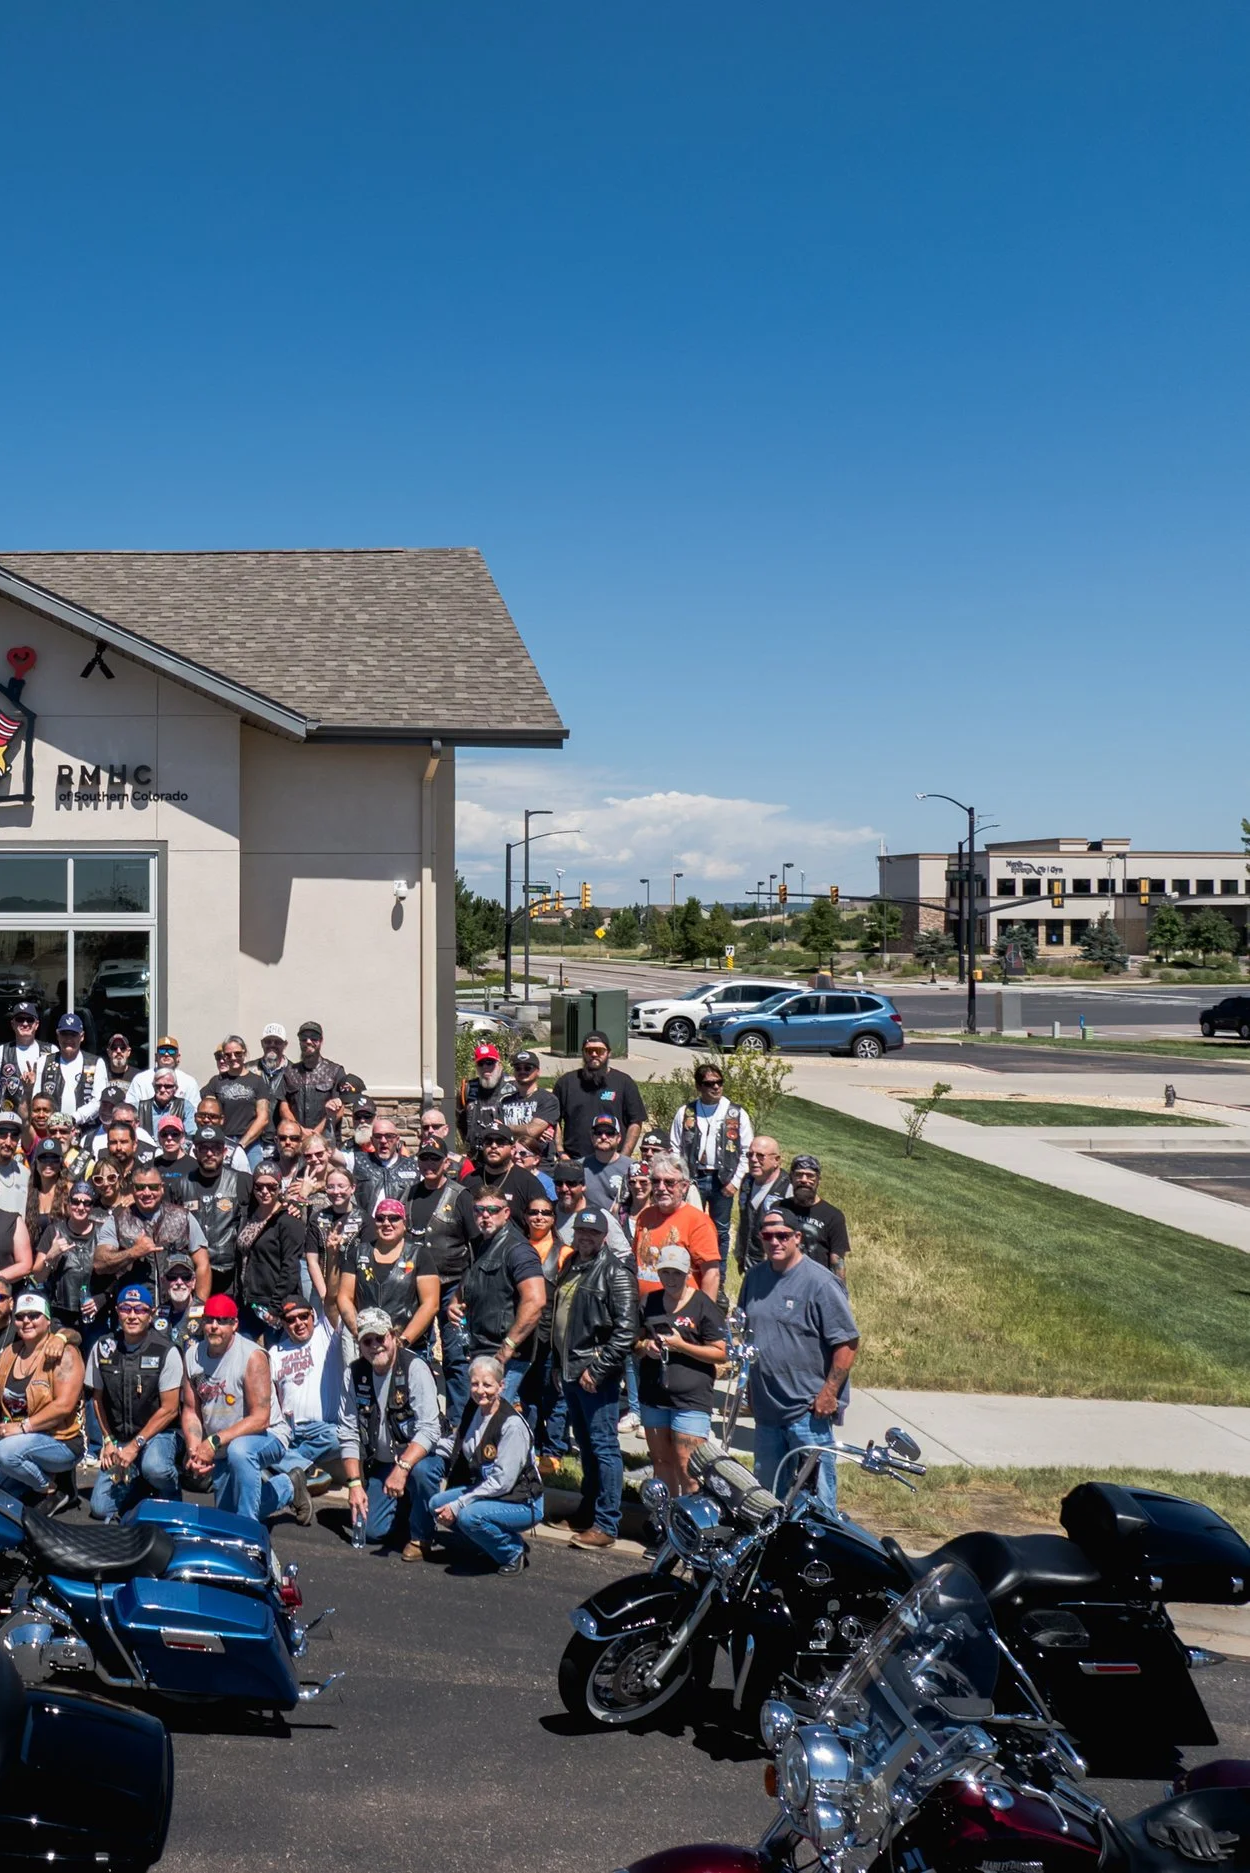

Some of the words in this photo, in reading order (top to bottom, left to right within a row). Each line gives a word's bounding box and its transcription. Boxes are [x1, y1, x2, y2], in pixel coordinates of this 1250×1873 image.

[58, 765, 152, 785] RMHC
[59, 792, 72, 801] of
[74, 791, 129, 802] Southern
[132, 790, 189, 801] Colorado
